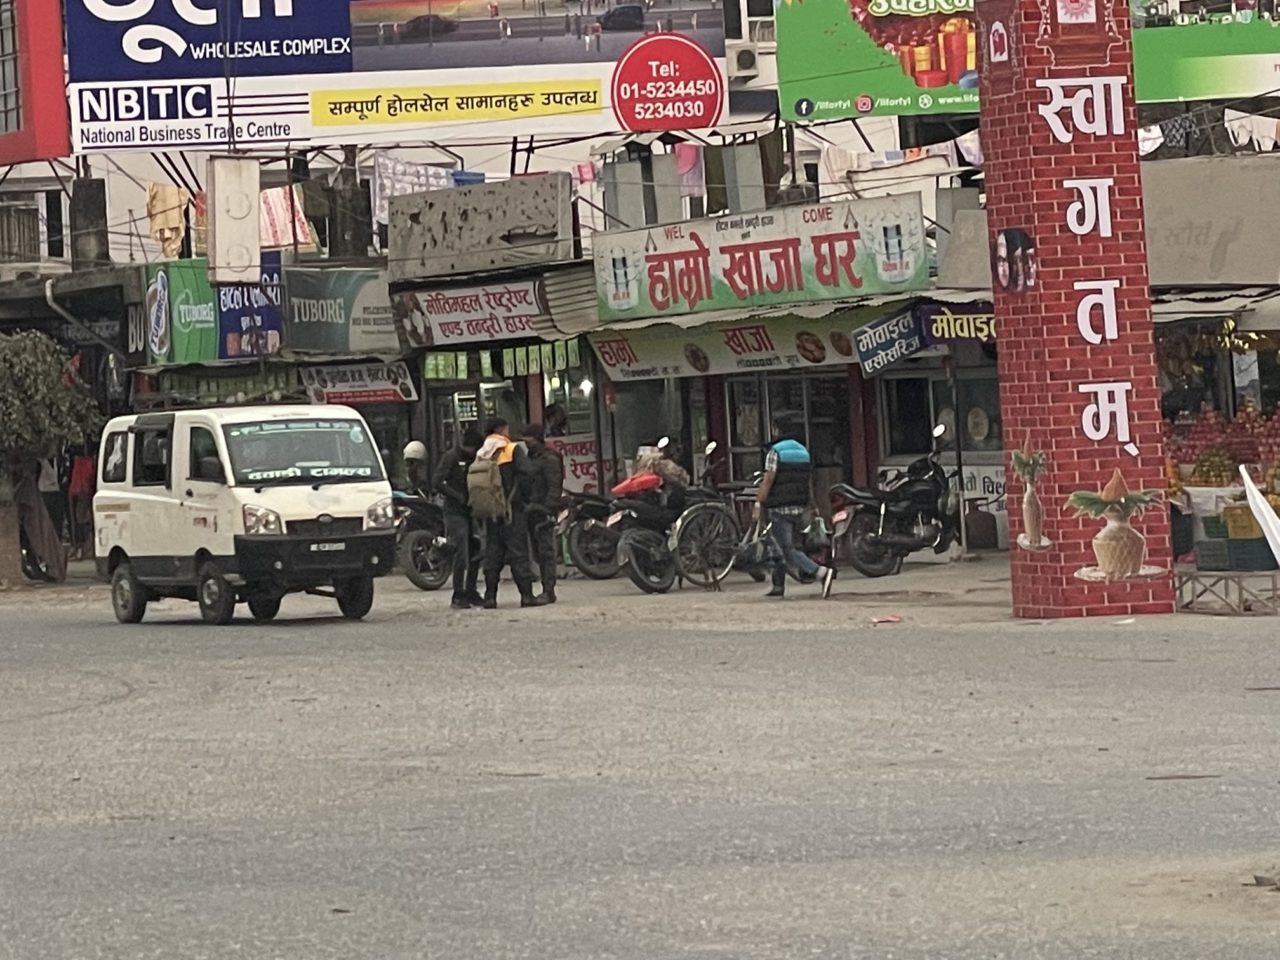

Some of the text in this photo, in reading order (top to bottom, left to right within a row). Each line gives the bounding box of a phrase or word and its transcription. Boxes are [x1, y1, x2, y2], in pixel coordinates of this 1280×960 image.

[189, 37, 351, 60] WHOLESALE COMPLEX
[648, 60, 680, 78] Tel:
[620, 79, 715, 99] 01-5234450
[81, 86, 210, 121] NBTC
[328, 94, 383, 121] सम्पूर्ण
[386, 92, 449, 117] होलसेल
[634, 101, 704, 120] 5234030
[81, 121, 291, 144] National Business Trade Centre
[664, 207, 834, 240] WEL COME
[645, 230, 864, 311] हाम्रो खाजा घर
[179, 302, 215, 322] TUBORG
[291, 297, 345, 324] TUBORG
